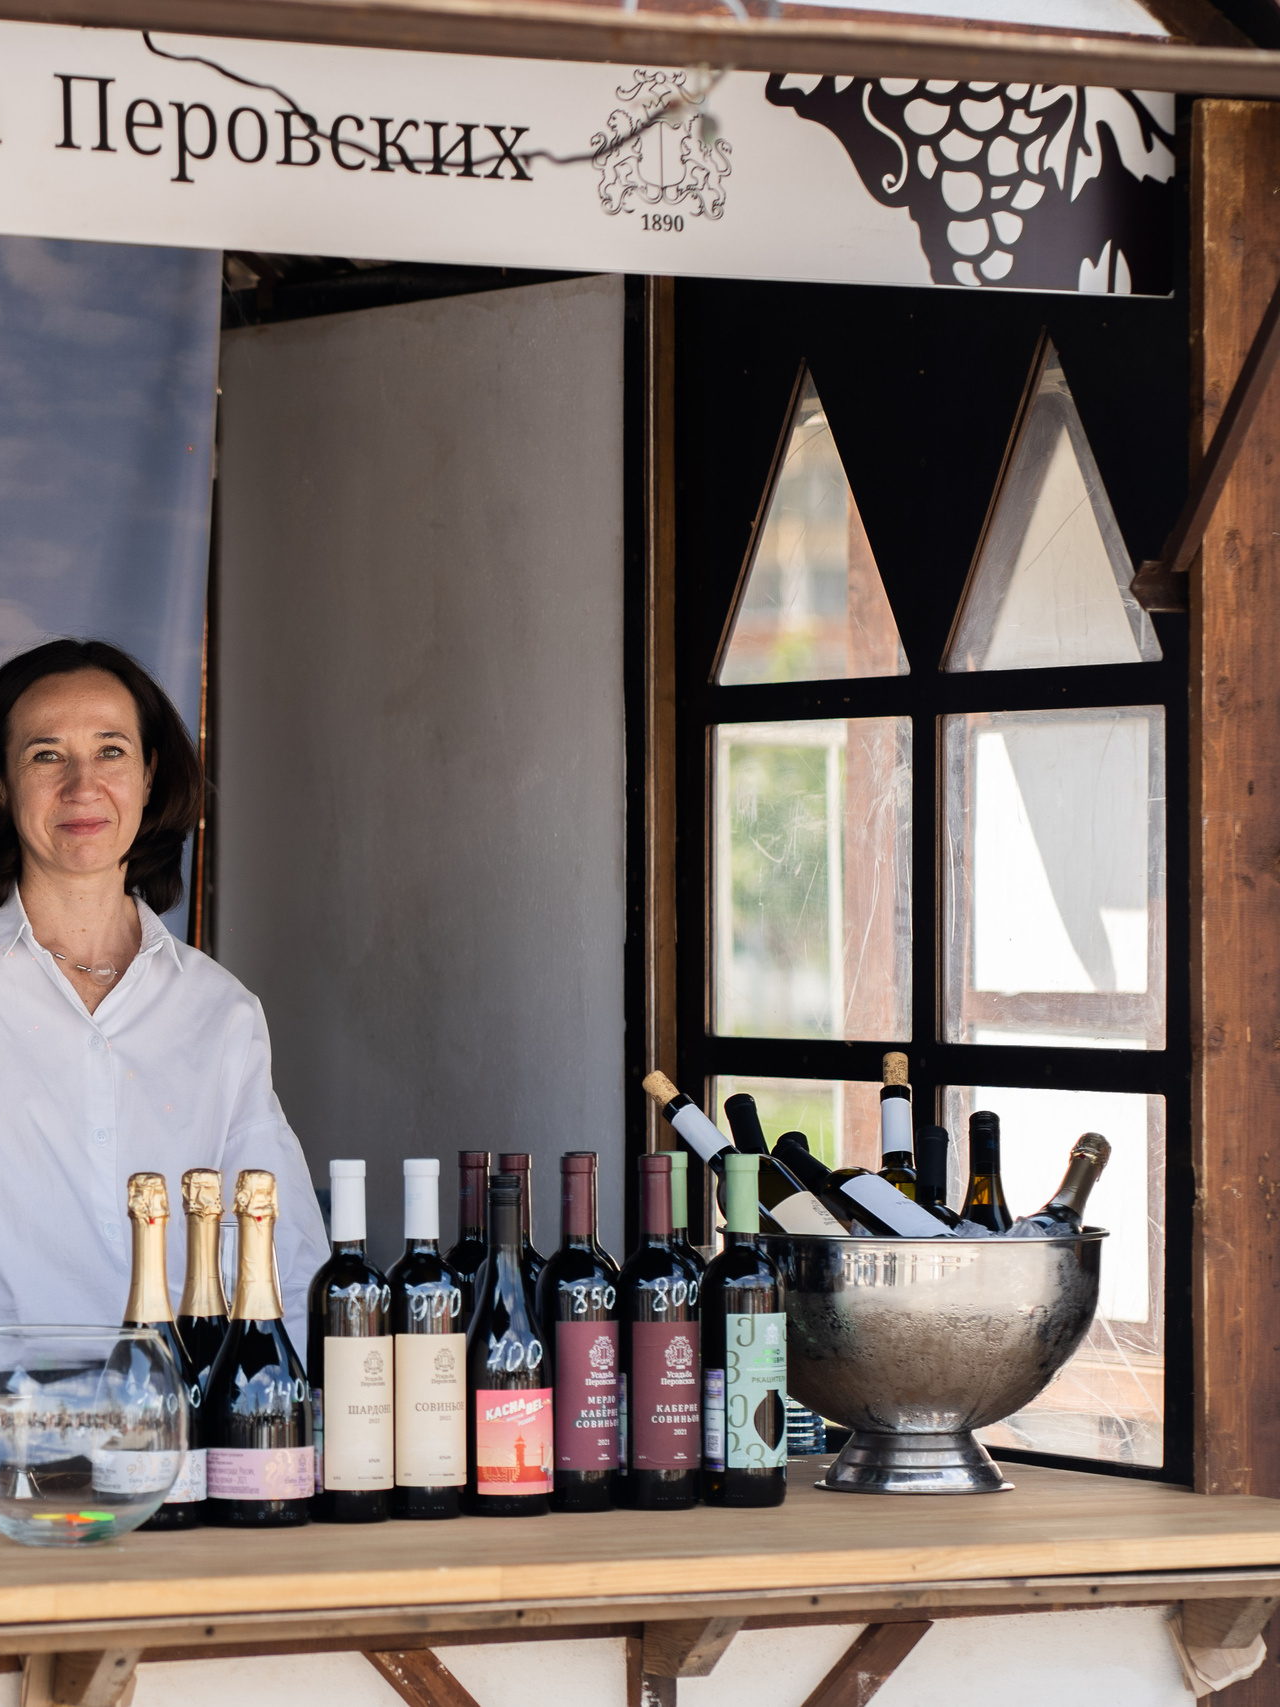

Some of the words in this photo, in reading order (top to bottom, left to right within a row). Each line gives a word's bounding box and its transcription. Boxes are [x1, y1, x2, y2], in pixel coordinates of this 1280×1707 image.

[53, 73, 534, 184] Перовских
[641, 213, 684, 233] 1890
[346, 1282, 391, 1320] 800
[410, 1288, 461, 1321] 900
[573, 1285, 616, 1314] 850
[653, 1277, 698, 1312] 800
[486, 1340, 542, 1372] 700
[590, 1371, 614, 1379] Усадьба
[665, 1371, 693, 1379] Усадьба
[588, 1395, 615, 1404] МЕРЛО
[656, 1403, 698, 1413] КАБЕРНЕ
